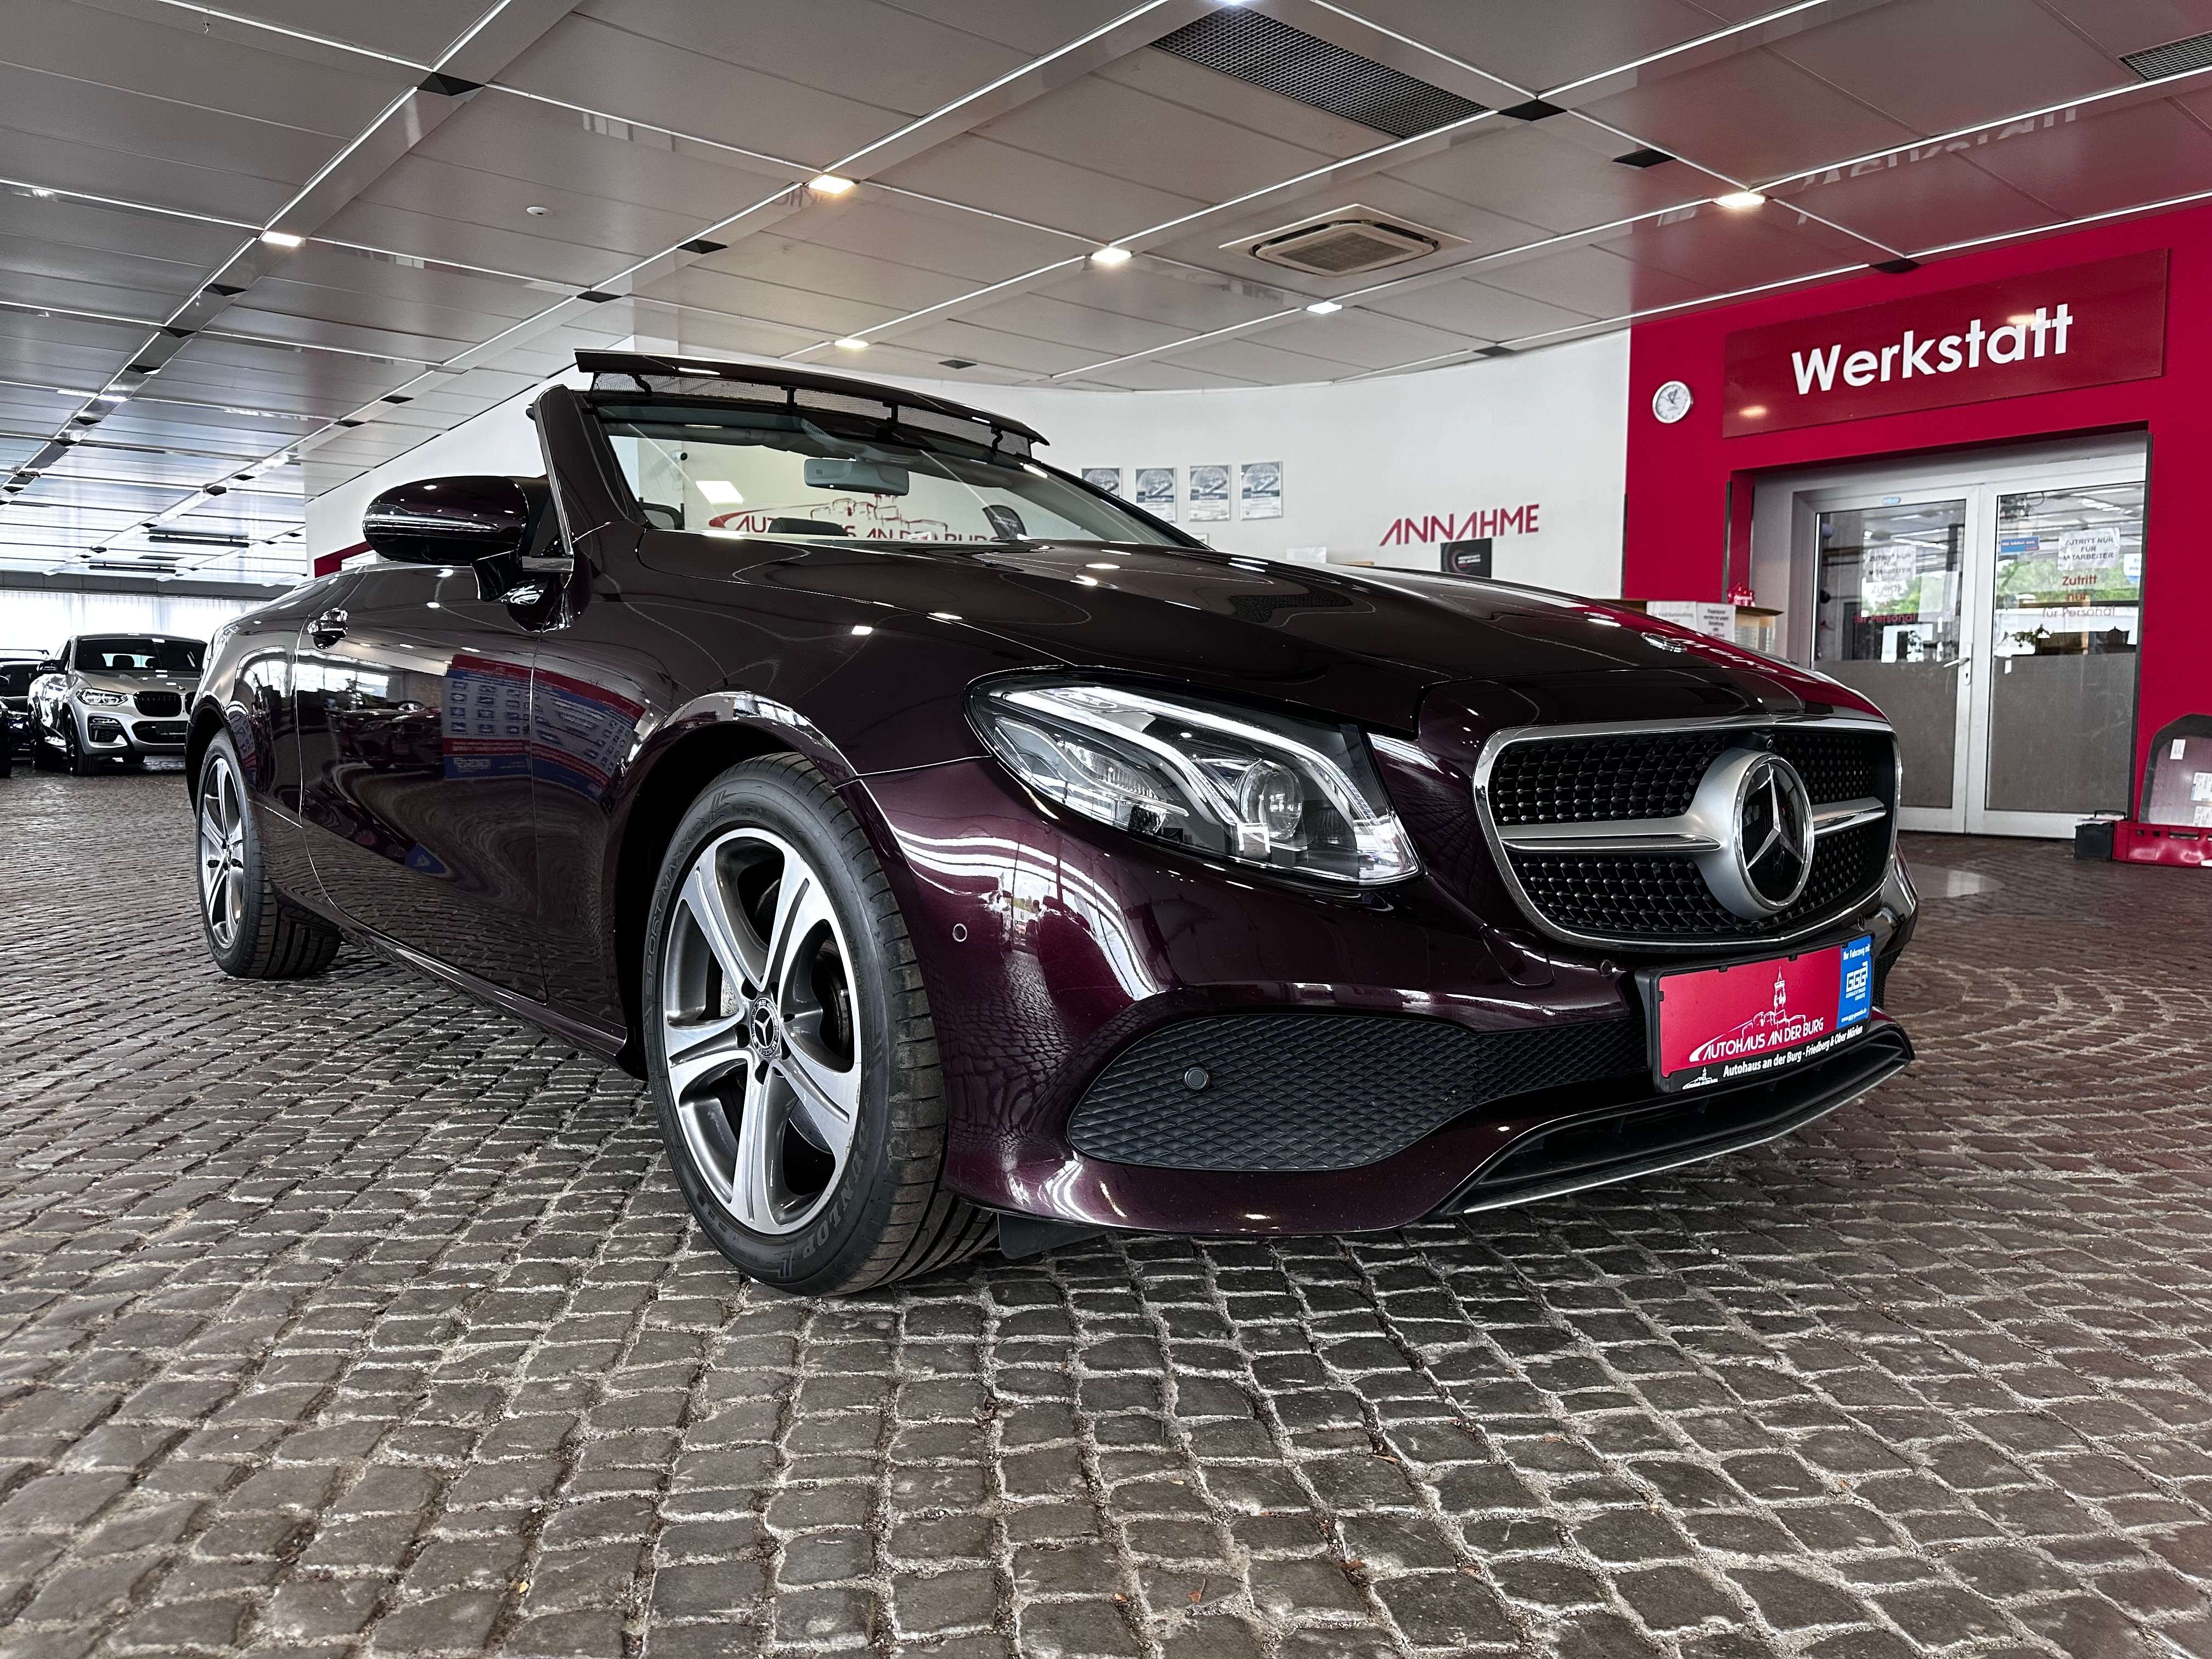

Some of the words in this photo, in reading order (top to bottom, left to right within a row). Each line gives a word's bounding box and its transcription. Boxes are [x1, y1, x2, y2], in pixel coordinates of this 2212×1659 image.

[1791, 303, 2073, 395] Werkstatt
[1379, 504, 1539, 546] ANNAHME
[2065, 538, 2095, 546] ZUTRITT
[2097, 535, 2113, 544] NUR
[2063, 552, 2114, 561] MTARBEITER
[2062, 574, 2097, 586] Zutritt
[1870, 613, 1915, 623] Personal
[2062, 605, 2115, 617] Personal
[645, 898, 662, 996] SPORT
[661, 831, 693, 896] MAXX
[1846, 964, 1868, 993] GGG
[1702, 1033, 1765, 1061] AUTOHAUS
[1767, 1030, 1782, 1047] AN
[1784, 1024, 1802, 1042] DER
[1803, 1017, 1824, 1037] BURG
[1723, 1060, 1761, 1077] Autohaus
[1762, 1058, 1772, 1069] an
[1774, 1054, 1785, 1066] der
[1786, 1051, 1802, 1063] Burg
[1805, 1040, 1830, 1057] Friedberg
[1830, 1035, 1835, 1047] &
[1835, 1032, 1847, 1045] Ober
[1847, 1025, 1863, 1040] Mörlen
[803, 1115, 871, 1259] DUNLOP
